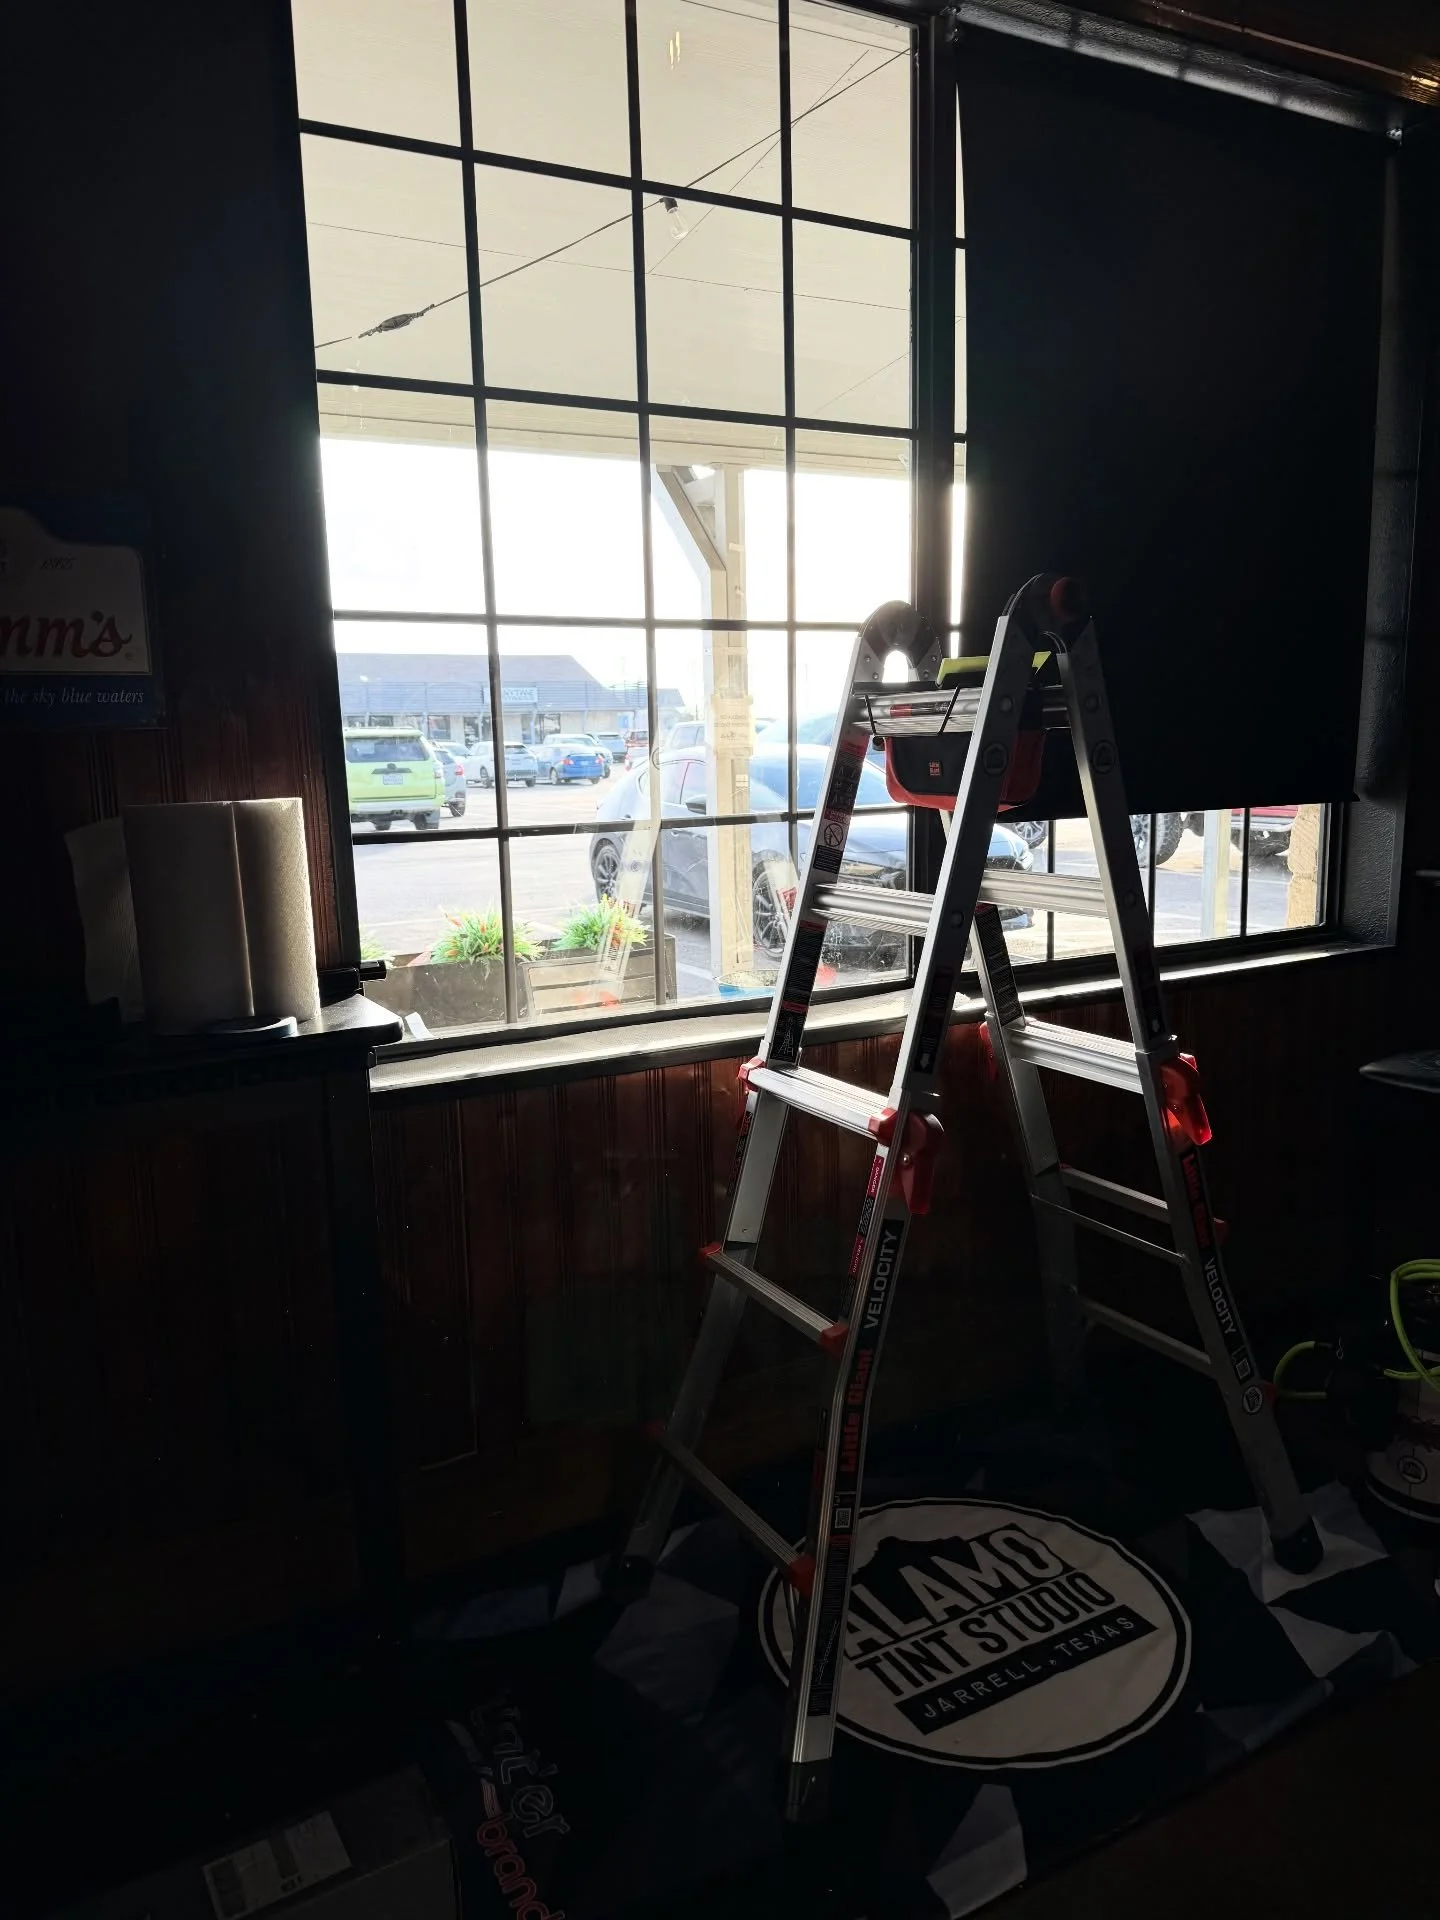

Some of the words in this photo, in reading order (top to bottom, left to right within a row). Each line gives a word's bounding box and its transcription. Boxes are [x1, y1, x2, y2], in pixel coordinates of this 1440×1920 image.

[4, 687, 25, 704] the
[33, 685, 56, 711] sky
[61, 687, 92, 704] blue
[97, 690, 145, 704] waters
[864, 1228, 898, 1330] VELOCITY
[1204, 1256, 1237, 1336] VELOCITY
[846, 1347, 874, 1406] Giant
[839, 1411, 863, 1473] Little
[845, 1530, 1064, 1660] ALAMO
[855, 1630, 970, 1696] TINT
[959, 1572, 1115, 1654] STUDIO
[1053, 1617, 1135, 1657] TEXAS
